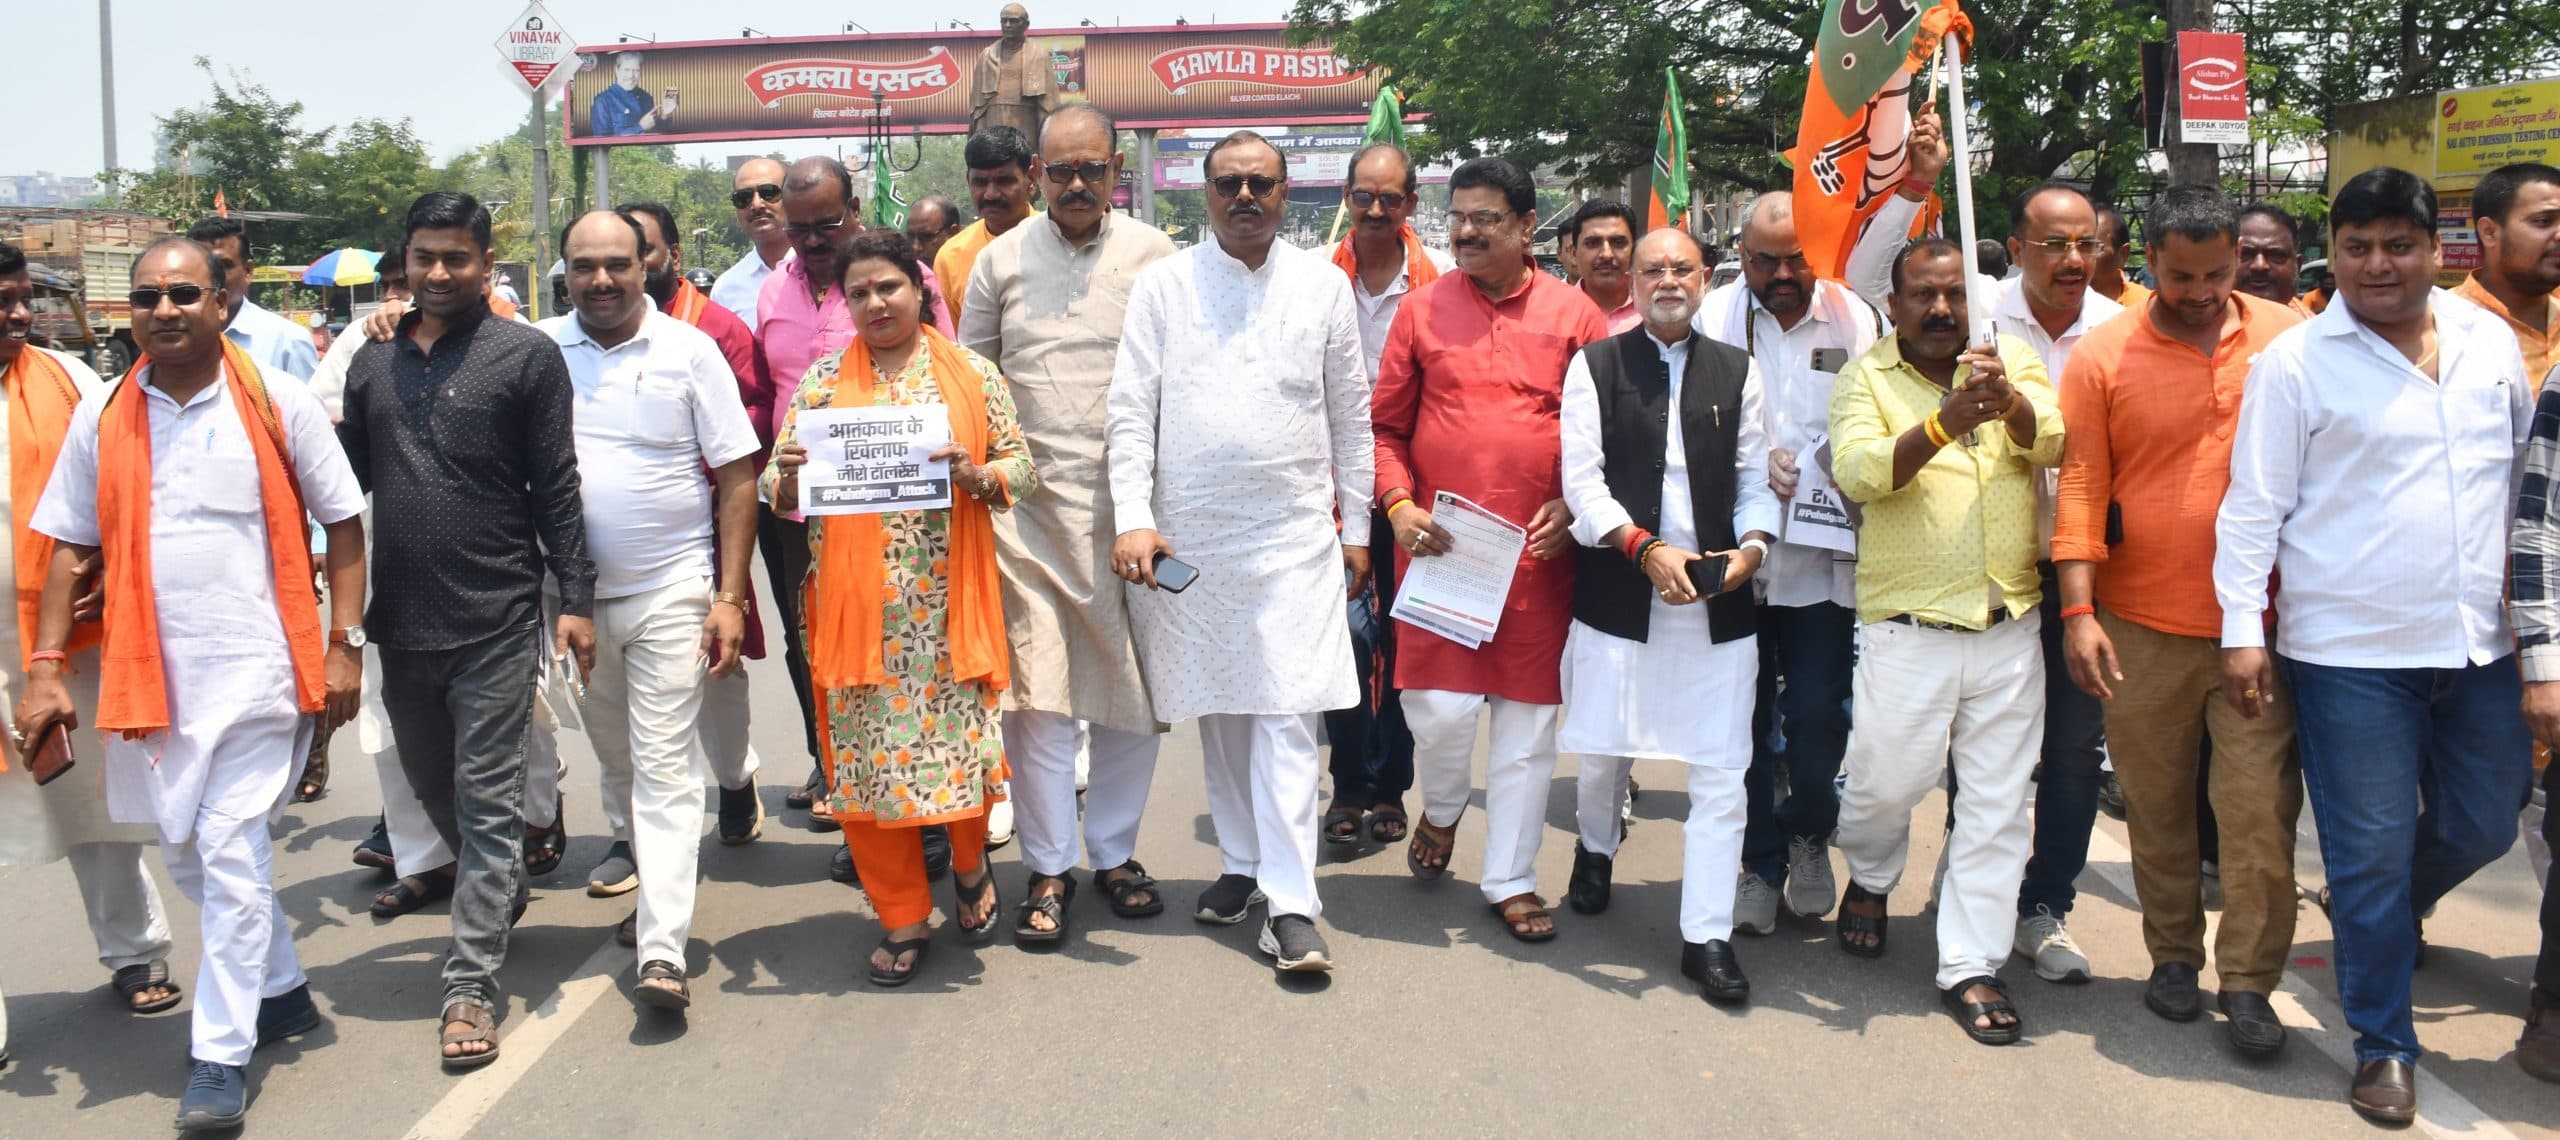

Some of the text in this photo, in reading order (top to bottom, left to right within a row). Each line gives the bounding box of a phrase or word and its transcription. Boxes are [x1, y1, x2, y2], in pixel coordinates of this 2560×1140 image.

[509, 31, 561, 44] VINAYAK
[513, 46, 556, 61] LIBRARY
[1167, 50, 1368, 84] KAMLA PASAN
[761, 63, 947, 92] कमला पसन्द
[1230, 95, 1250, 103] SILVER
[1251, 94, 1275, 102] COATED
[1314, 136, 1362, 147] आपका
[828, 416, 924, 439] आतंकवाद के
[844, 440, 909, 461] खिलाफ
[836, 463, 868, 482] जीरो
